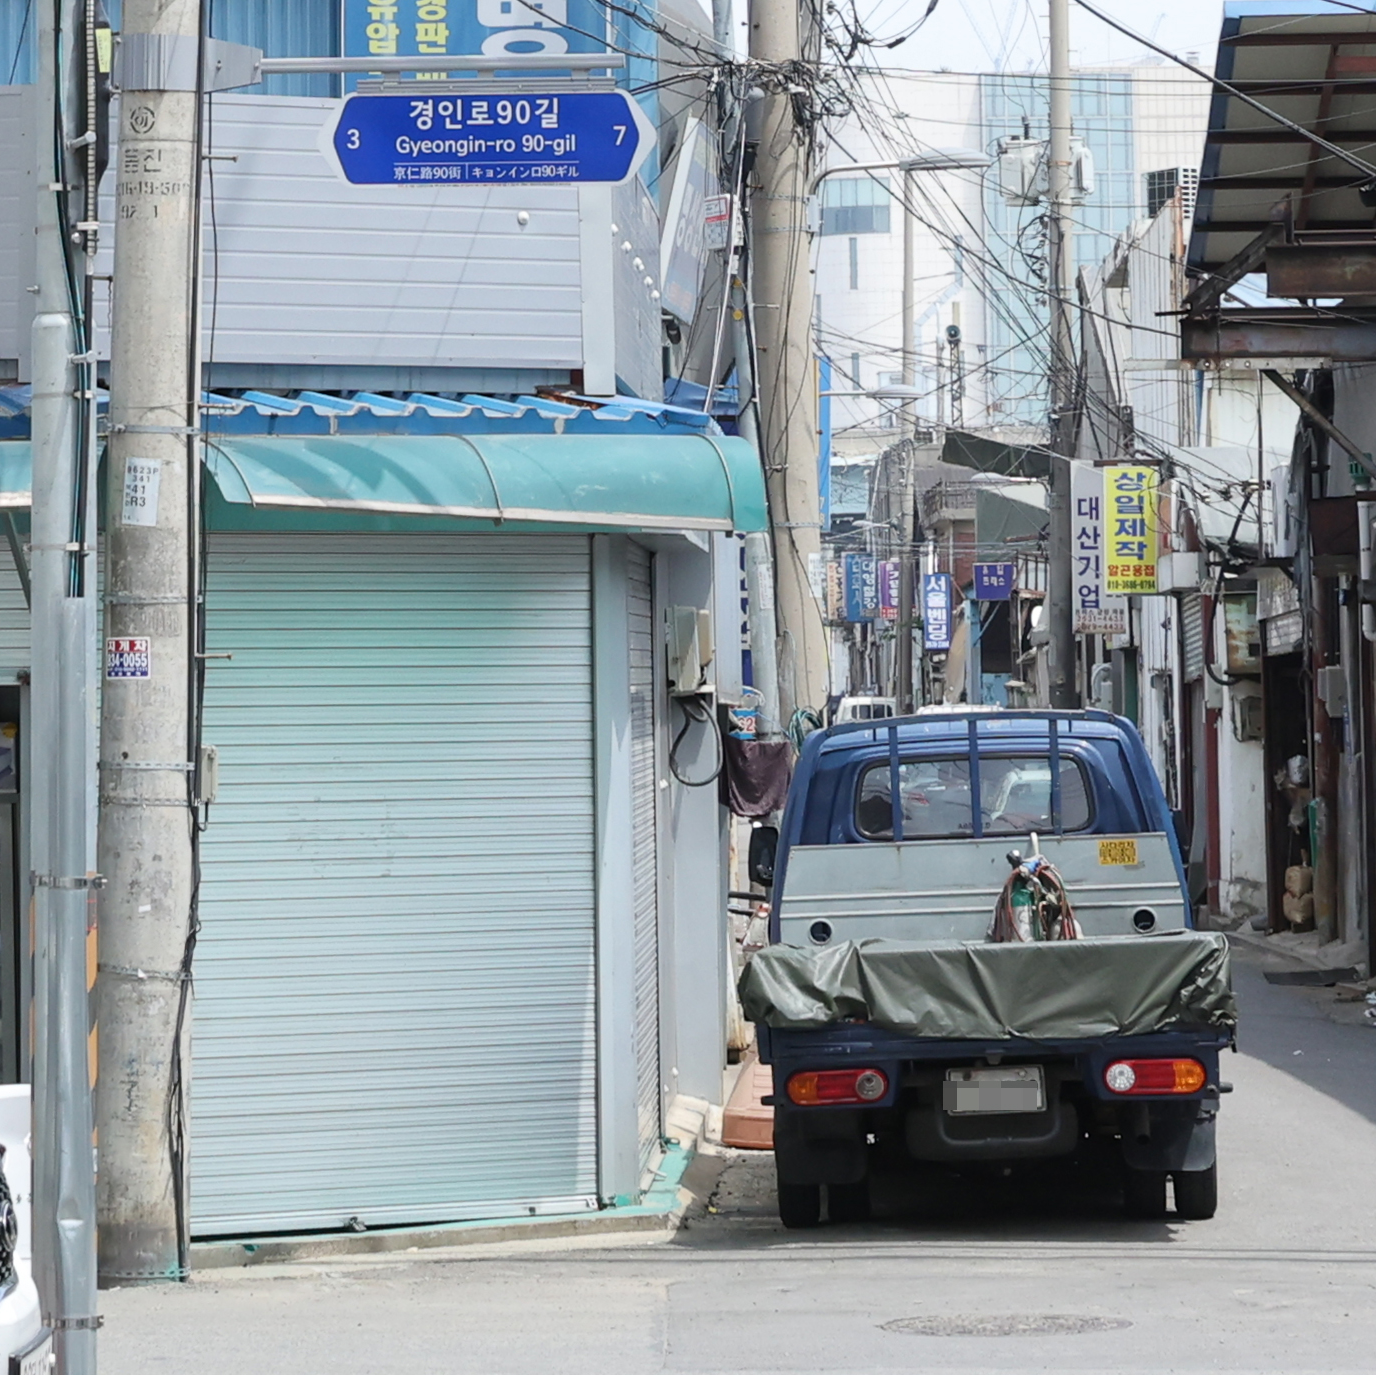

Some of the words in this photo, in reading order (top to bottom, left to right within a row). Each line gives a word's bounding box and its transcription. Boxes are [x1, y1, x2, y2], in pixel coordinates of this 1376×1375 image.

[409, 98, 560, 129] 경인로90길
[347, 129, 361, 149] 3
[396, 135, 516, 157] Gyeongin-ro
[522, 133, 576, 154] 90-gil
[613, 125, 627, 145] 7
[393, 165, 462, 180] 京仁路90街
[1114, 472, 1148, 561] 상일제작
[1076, 496, 1101, 609] 대산기업
[982, 576, 1006, 587] 프레스
[1107, 565, 1156, 577] 알곤용접
[926, 576, 947, 641] 서울벤딩
